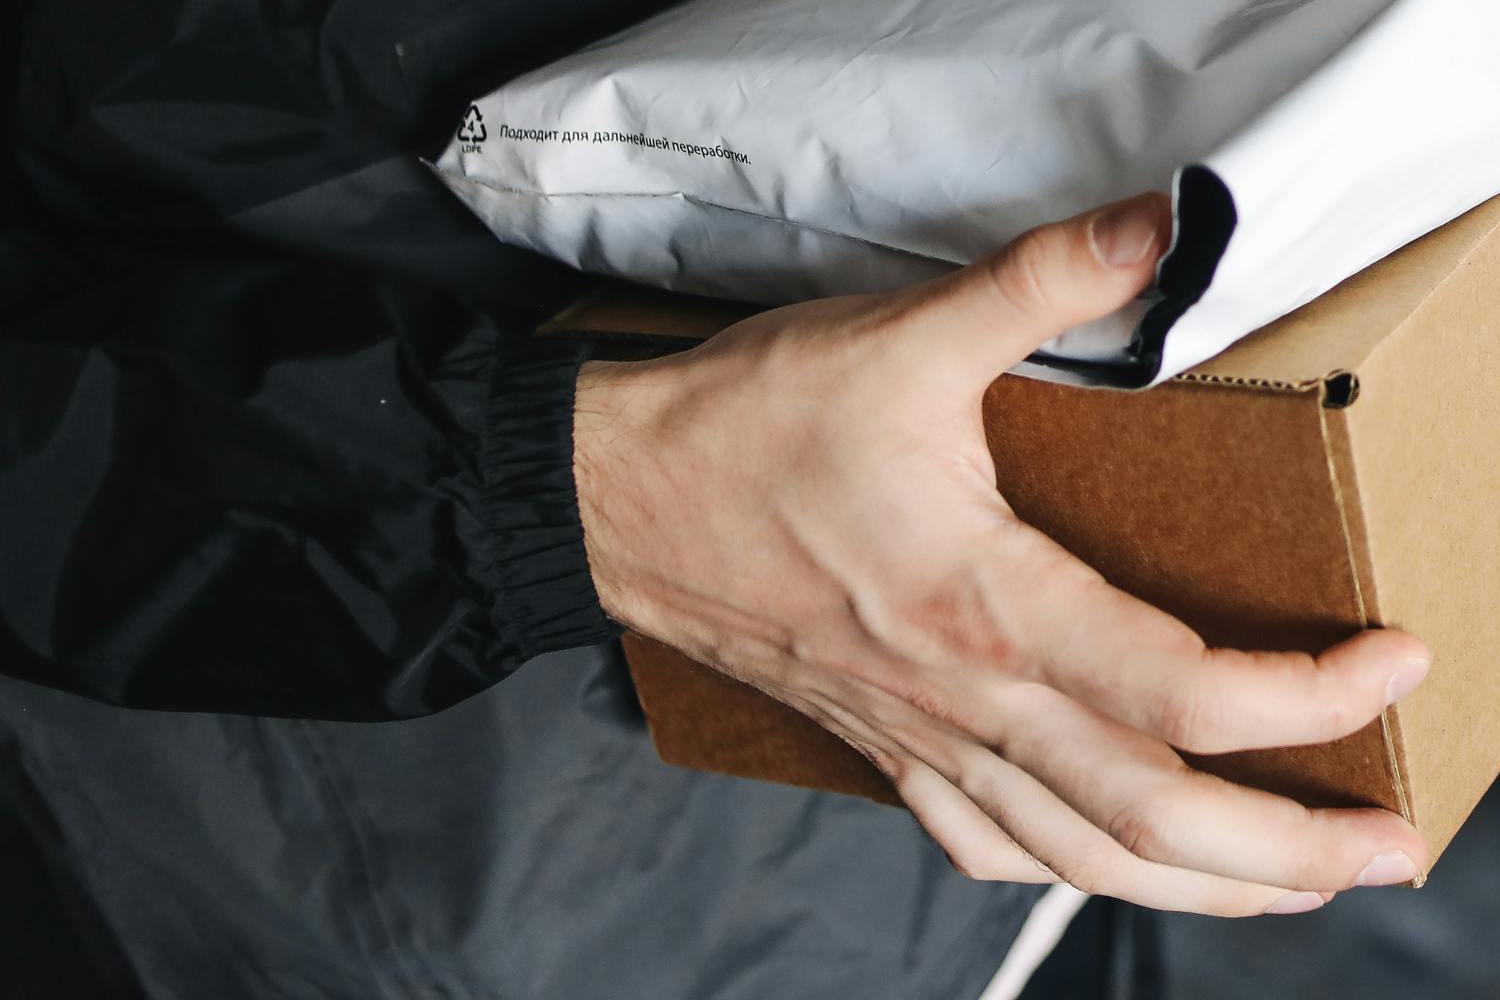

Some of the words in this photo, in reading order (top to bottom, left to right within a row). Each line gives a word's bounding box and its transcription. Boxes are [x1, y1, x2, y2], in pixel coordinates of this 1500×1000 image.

[499, 124, 559, 143] Подходит
[561, 130, 589, 143] для
[592, 131, 670, 151] дальнейшей
[671, 139, 752, 166] переработки.
